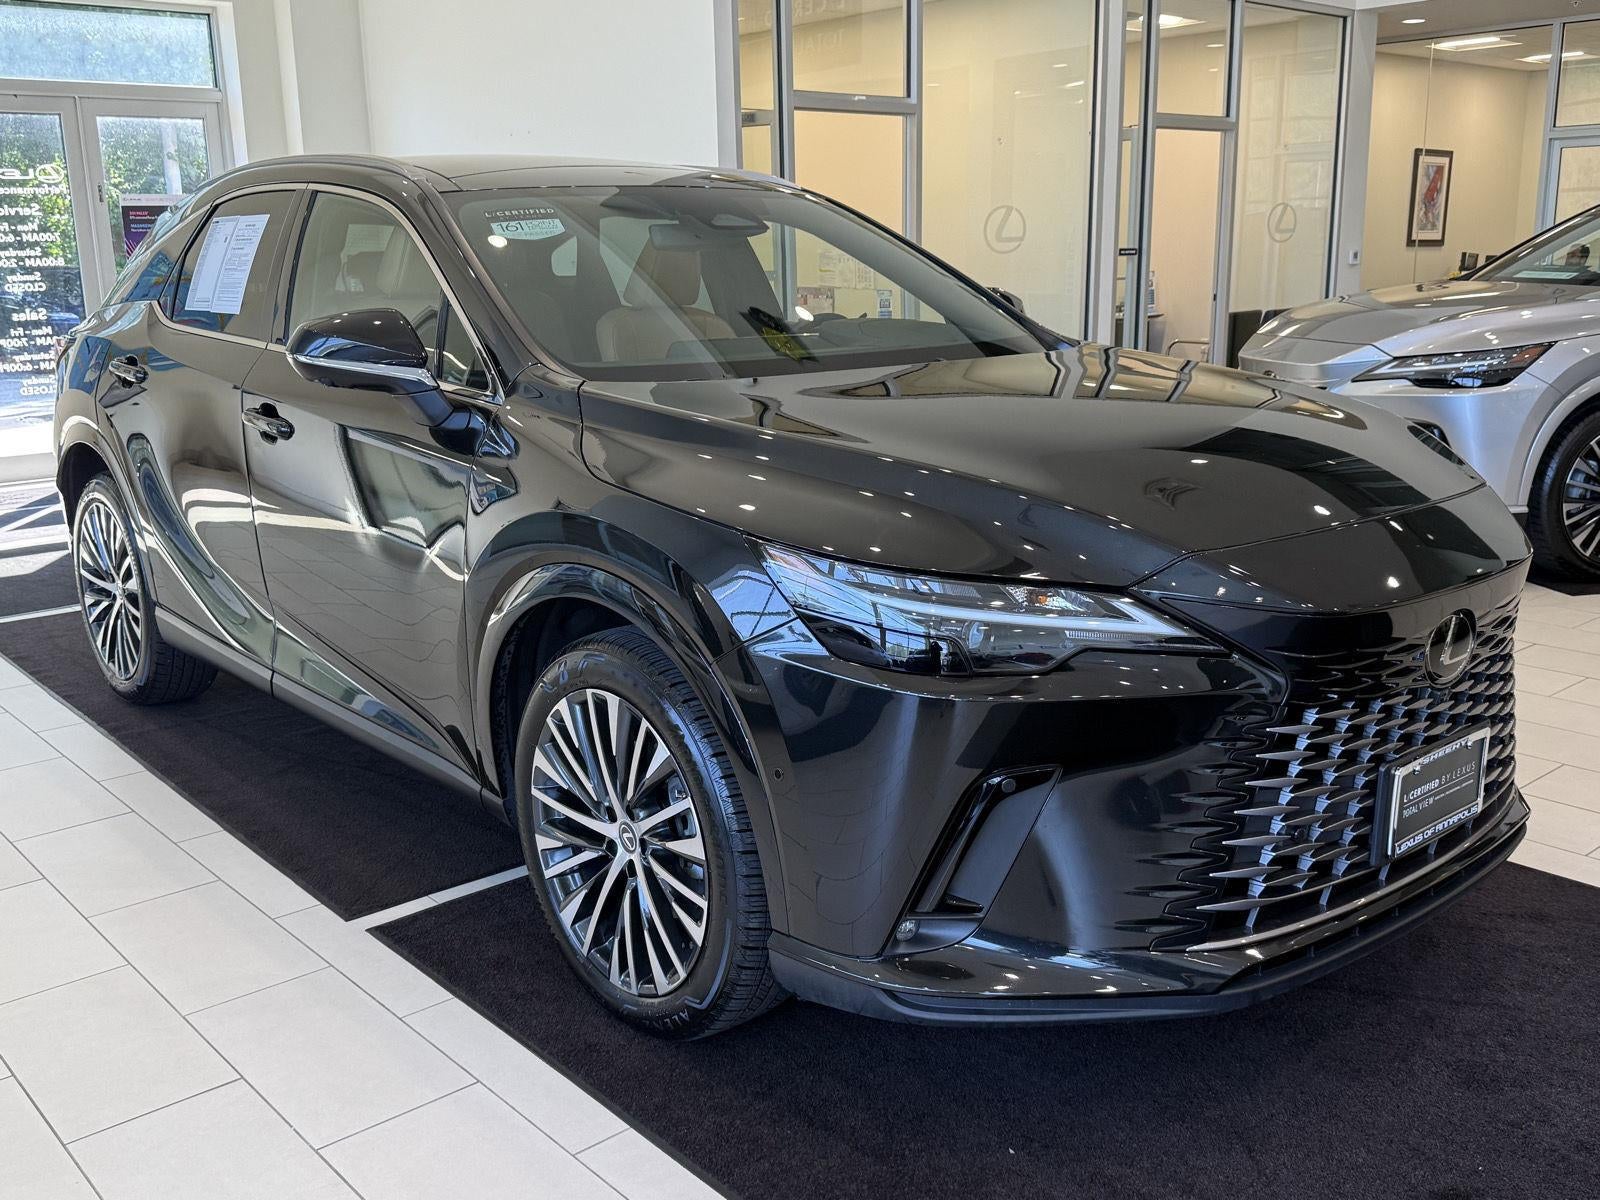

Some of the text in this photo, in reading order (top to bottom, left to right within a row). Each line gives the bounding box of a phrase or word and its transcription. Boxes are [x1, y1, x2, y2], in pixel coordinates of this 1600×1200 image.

[496, 221, 525, 233] 161
[1441, 773, 1451, 785] BY
[1453, 761, 1476, 779] LEXUS
[1396, 833, 1424, 854] LEXUS
[1423, 826, 1435, 839] OF
